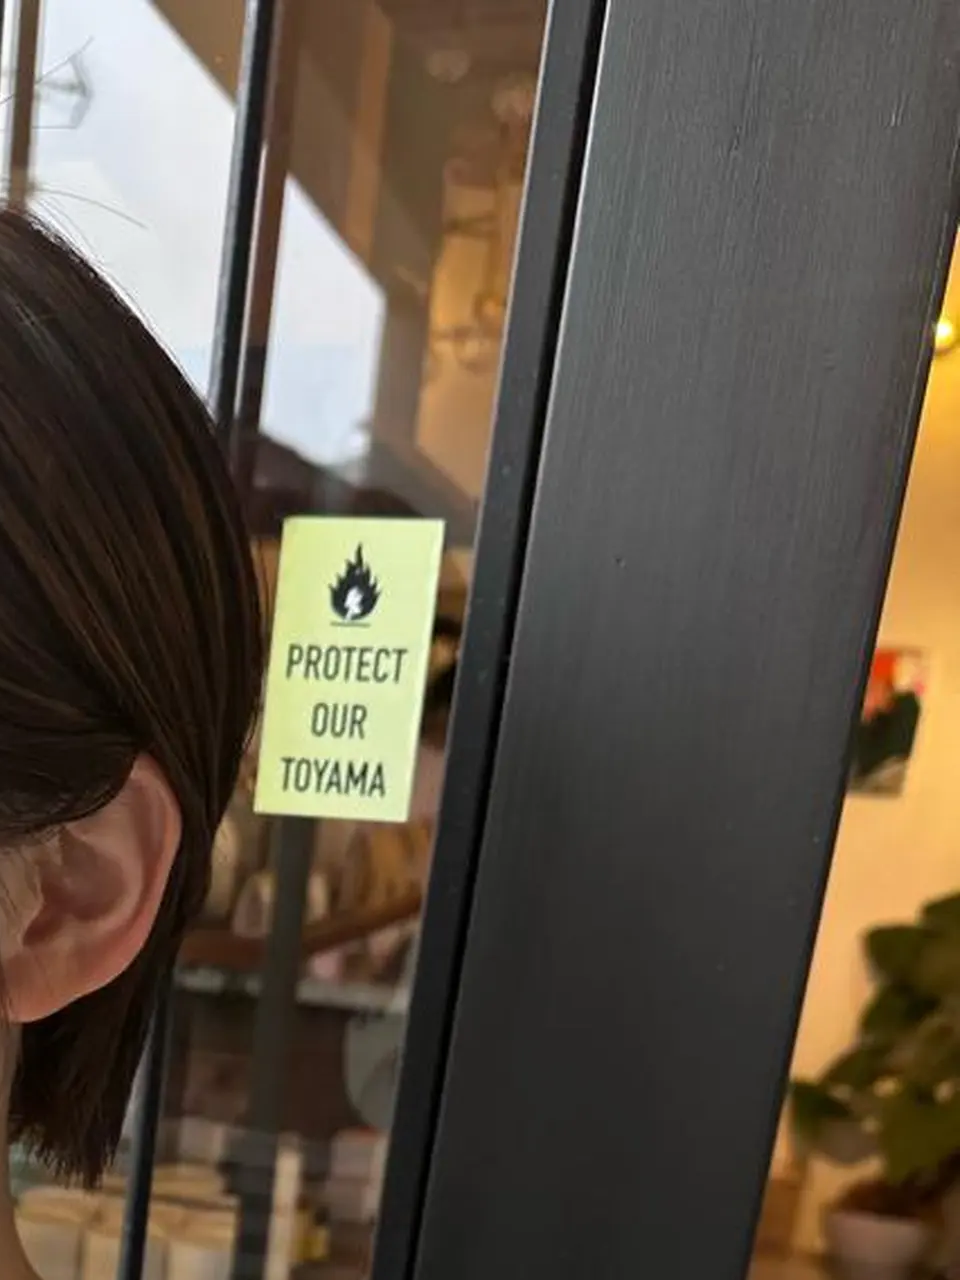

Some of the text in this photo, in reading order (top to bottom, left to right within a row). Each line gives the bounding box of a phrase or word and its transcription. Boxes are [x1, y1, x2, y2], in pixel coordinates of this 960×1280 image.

[286, 643, 408, 684] PROTECT
[311, 702, 368, 740] OUR
[281, 756, 386, 798] TOYAMA
